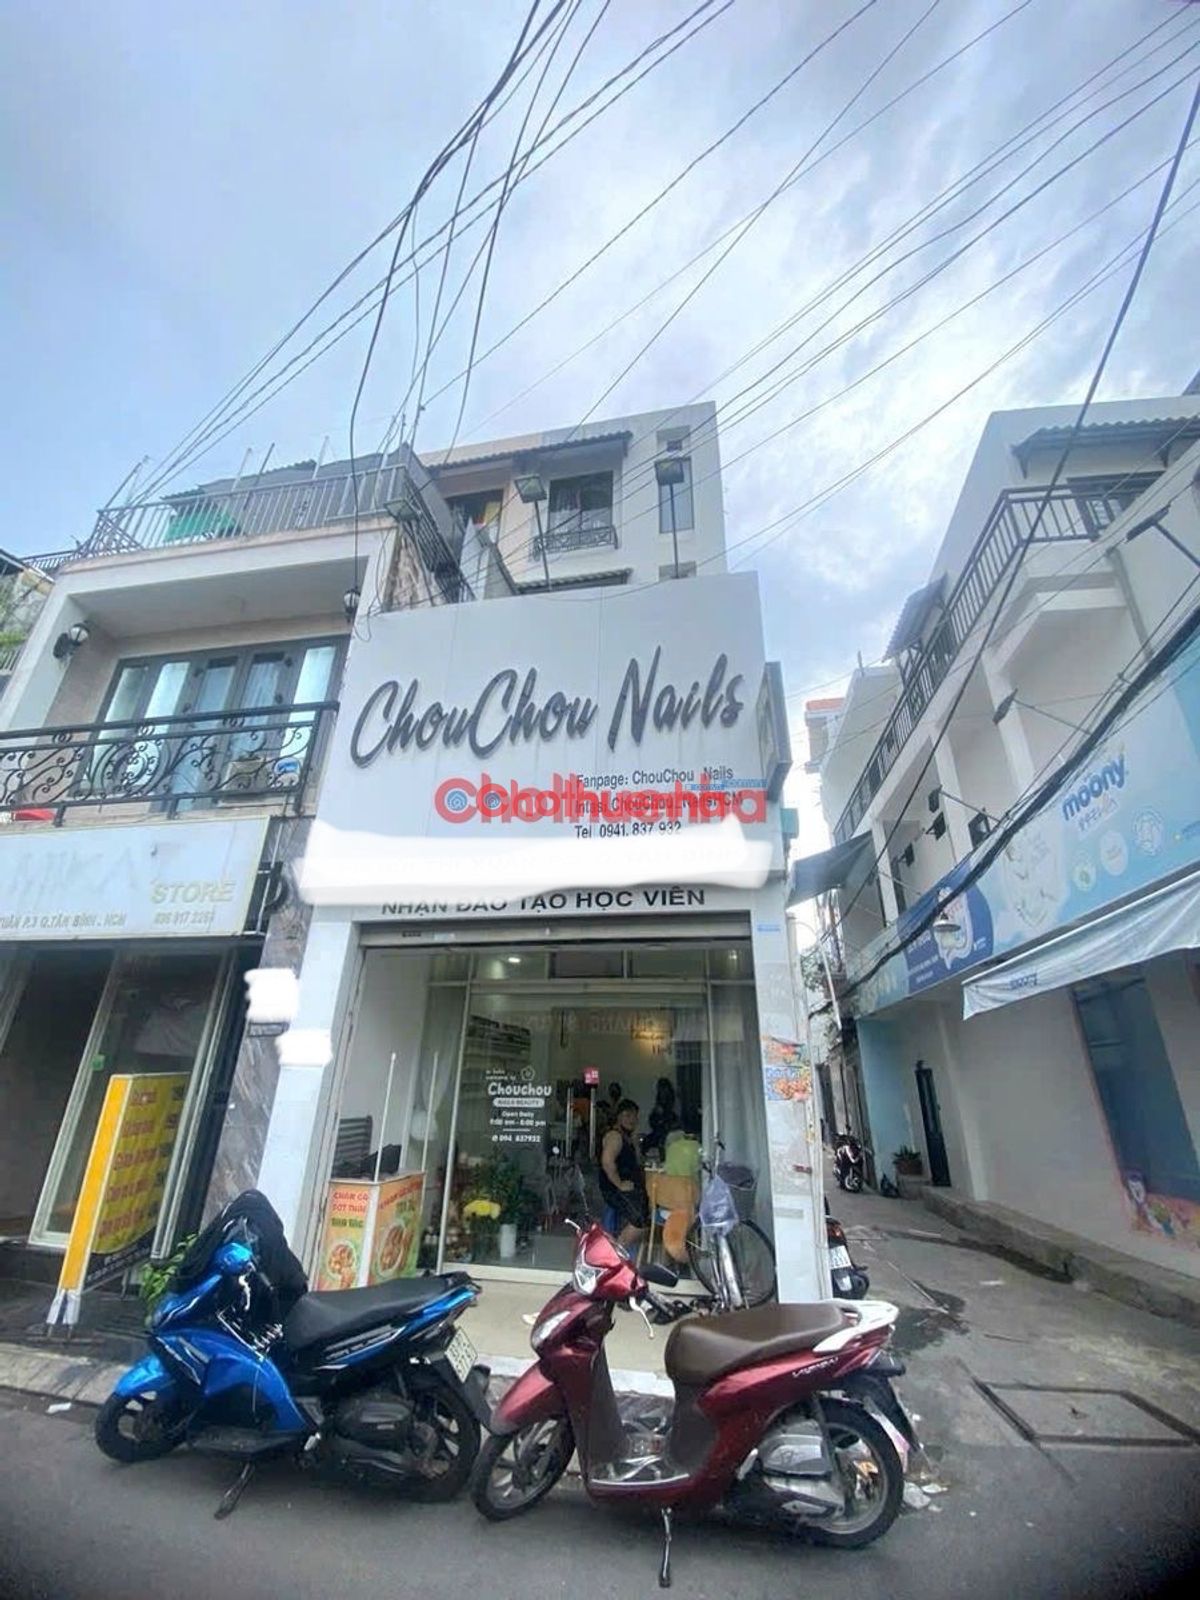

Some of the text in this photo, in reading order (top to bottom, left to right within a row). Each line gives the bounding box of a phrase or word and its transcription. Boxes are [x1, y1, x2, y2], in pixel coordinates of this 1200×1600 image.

[350, 645, 745, 769] ChouChou Nails
[632, 767, 695, 785] ChouChou
[1063, 754, 1125, 821] moony
[575, 825, 592, 839] Tel
[151, 880, 237, 904] STORE
[576, 890, 634, 911] HỌC
[643, 885, 705, 906] VIÊN
[487, 1081, 552, 1097] Chouchou
